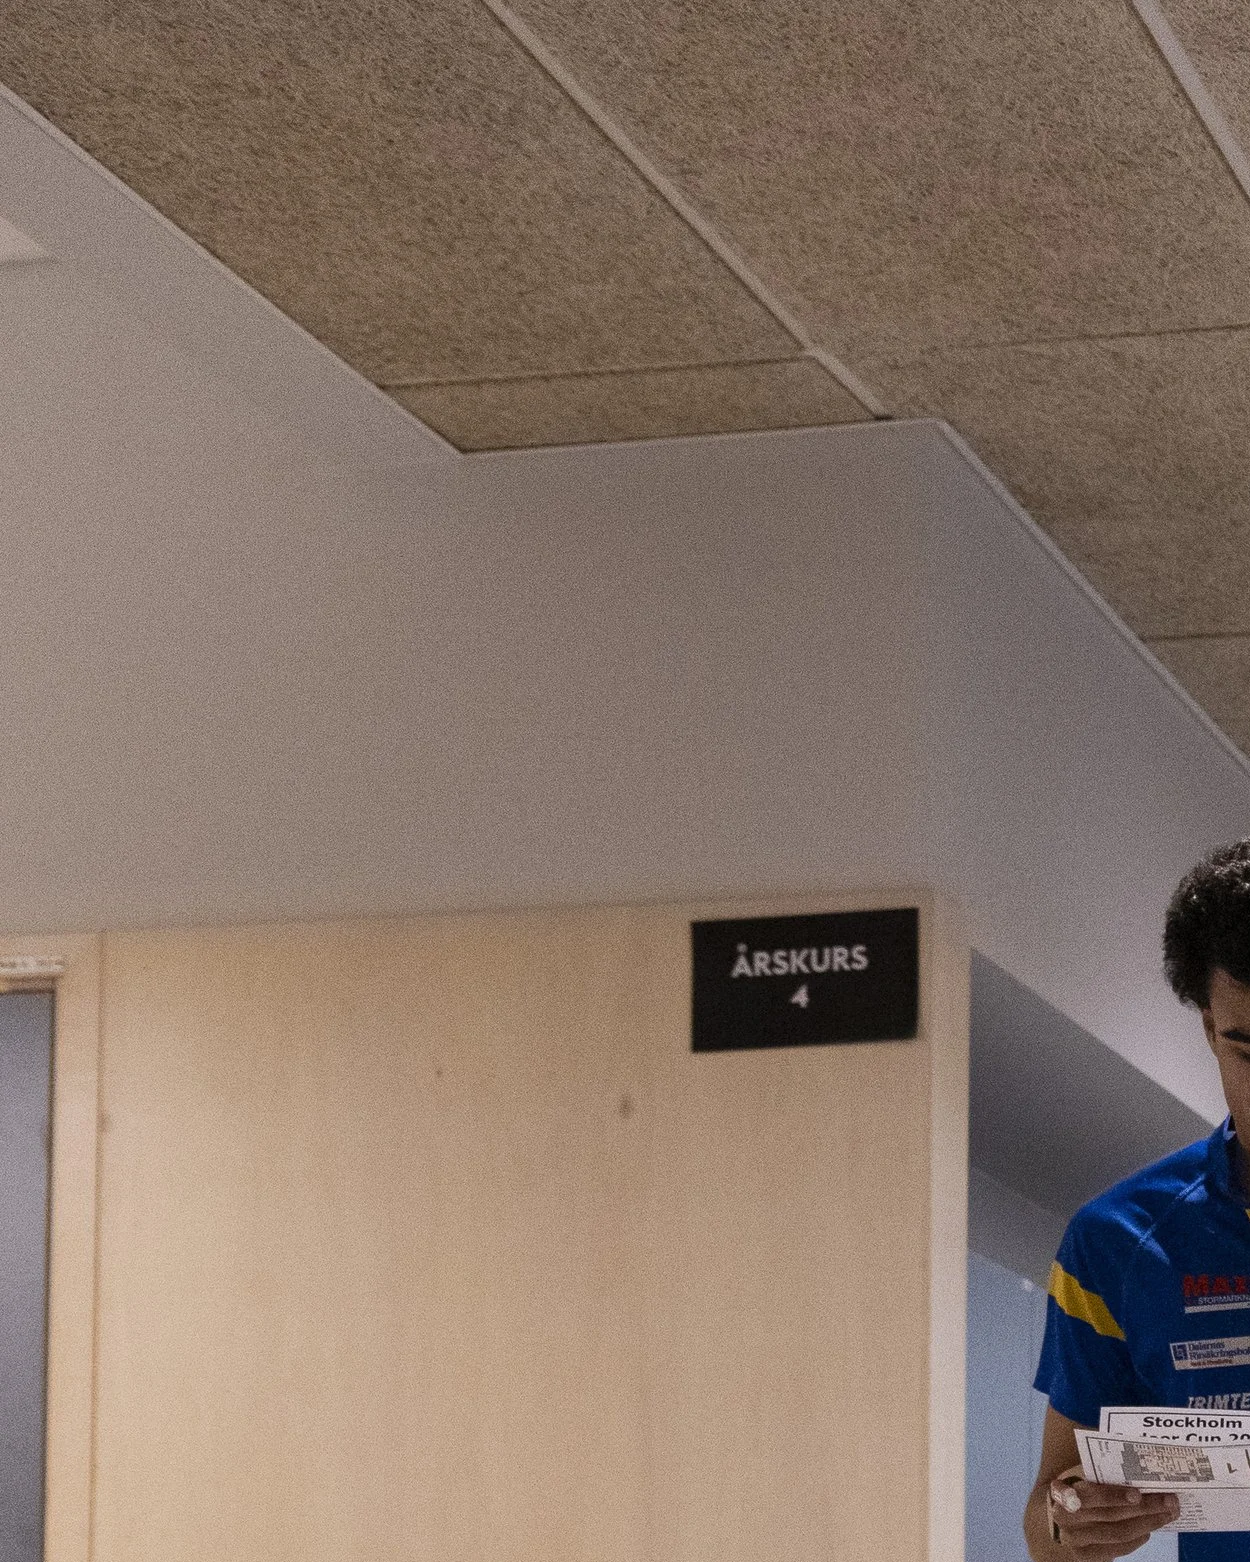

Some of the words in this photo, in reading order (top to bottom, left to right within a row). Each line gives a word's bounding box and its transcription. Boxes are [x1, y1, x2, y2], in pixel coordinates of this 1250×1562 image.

[731, 943, 869, 978] ÅRSKURS
[790, 985, 809, 1007] 4
[1143, 1416, 1242, 1429] Stockholm
